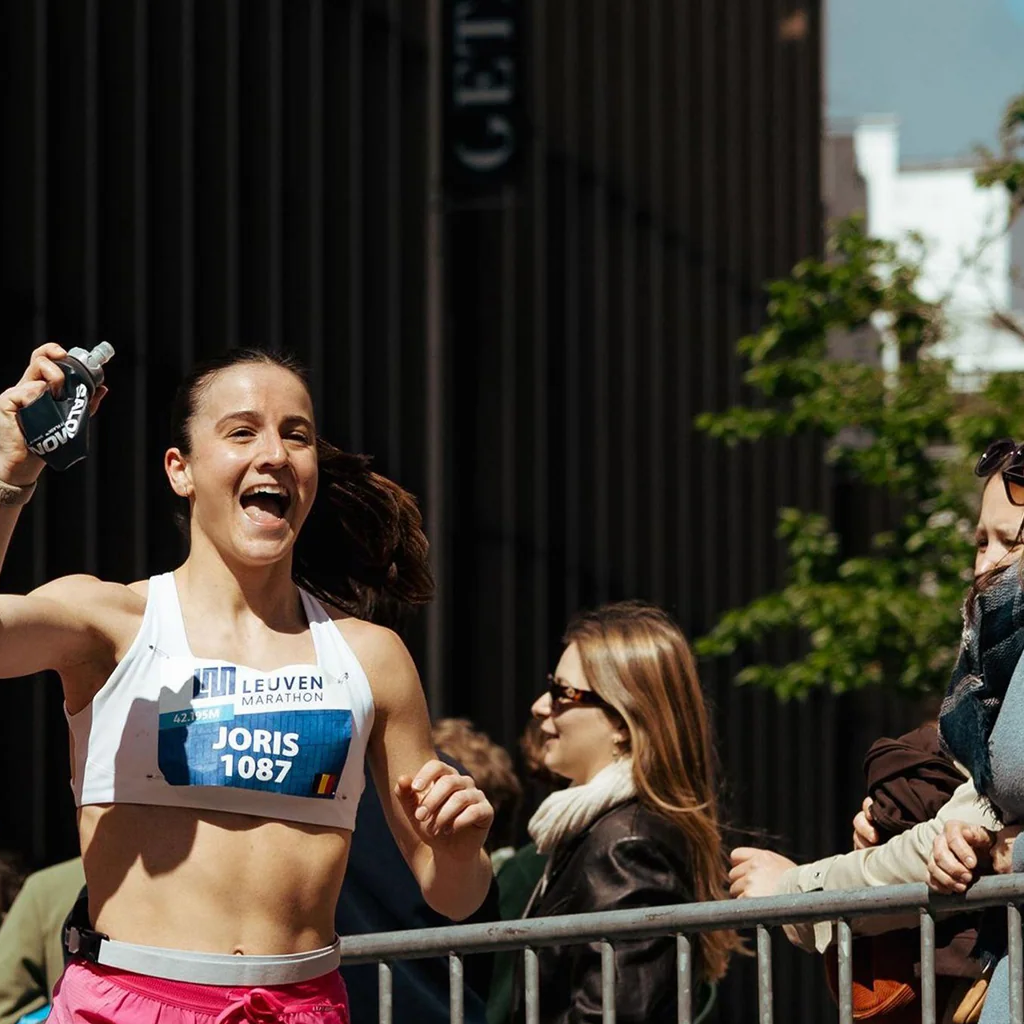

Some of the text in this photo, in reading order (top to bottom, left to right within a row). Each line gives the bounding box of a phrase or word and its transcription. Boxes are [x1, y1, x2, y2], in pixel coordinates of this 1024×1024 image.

[29, 383, 88, 456] SALOMON
[241, 692, 324, 706] MARATHON
[242, 675, 324, 694] LEUVEN
[212, 726, 300, 757] JORIS
[220, 754, 293, 784] 1087
